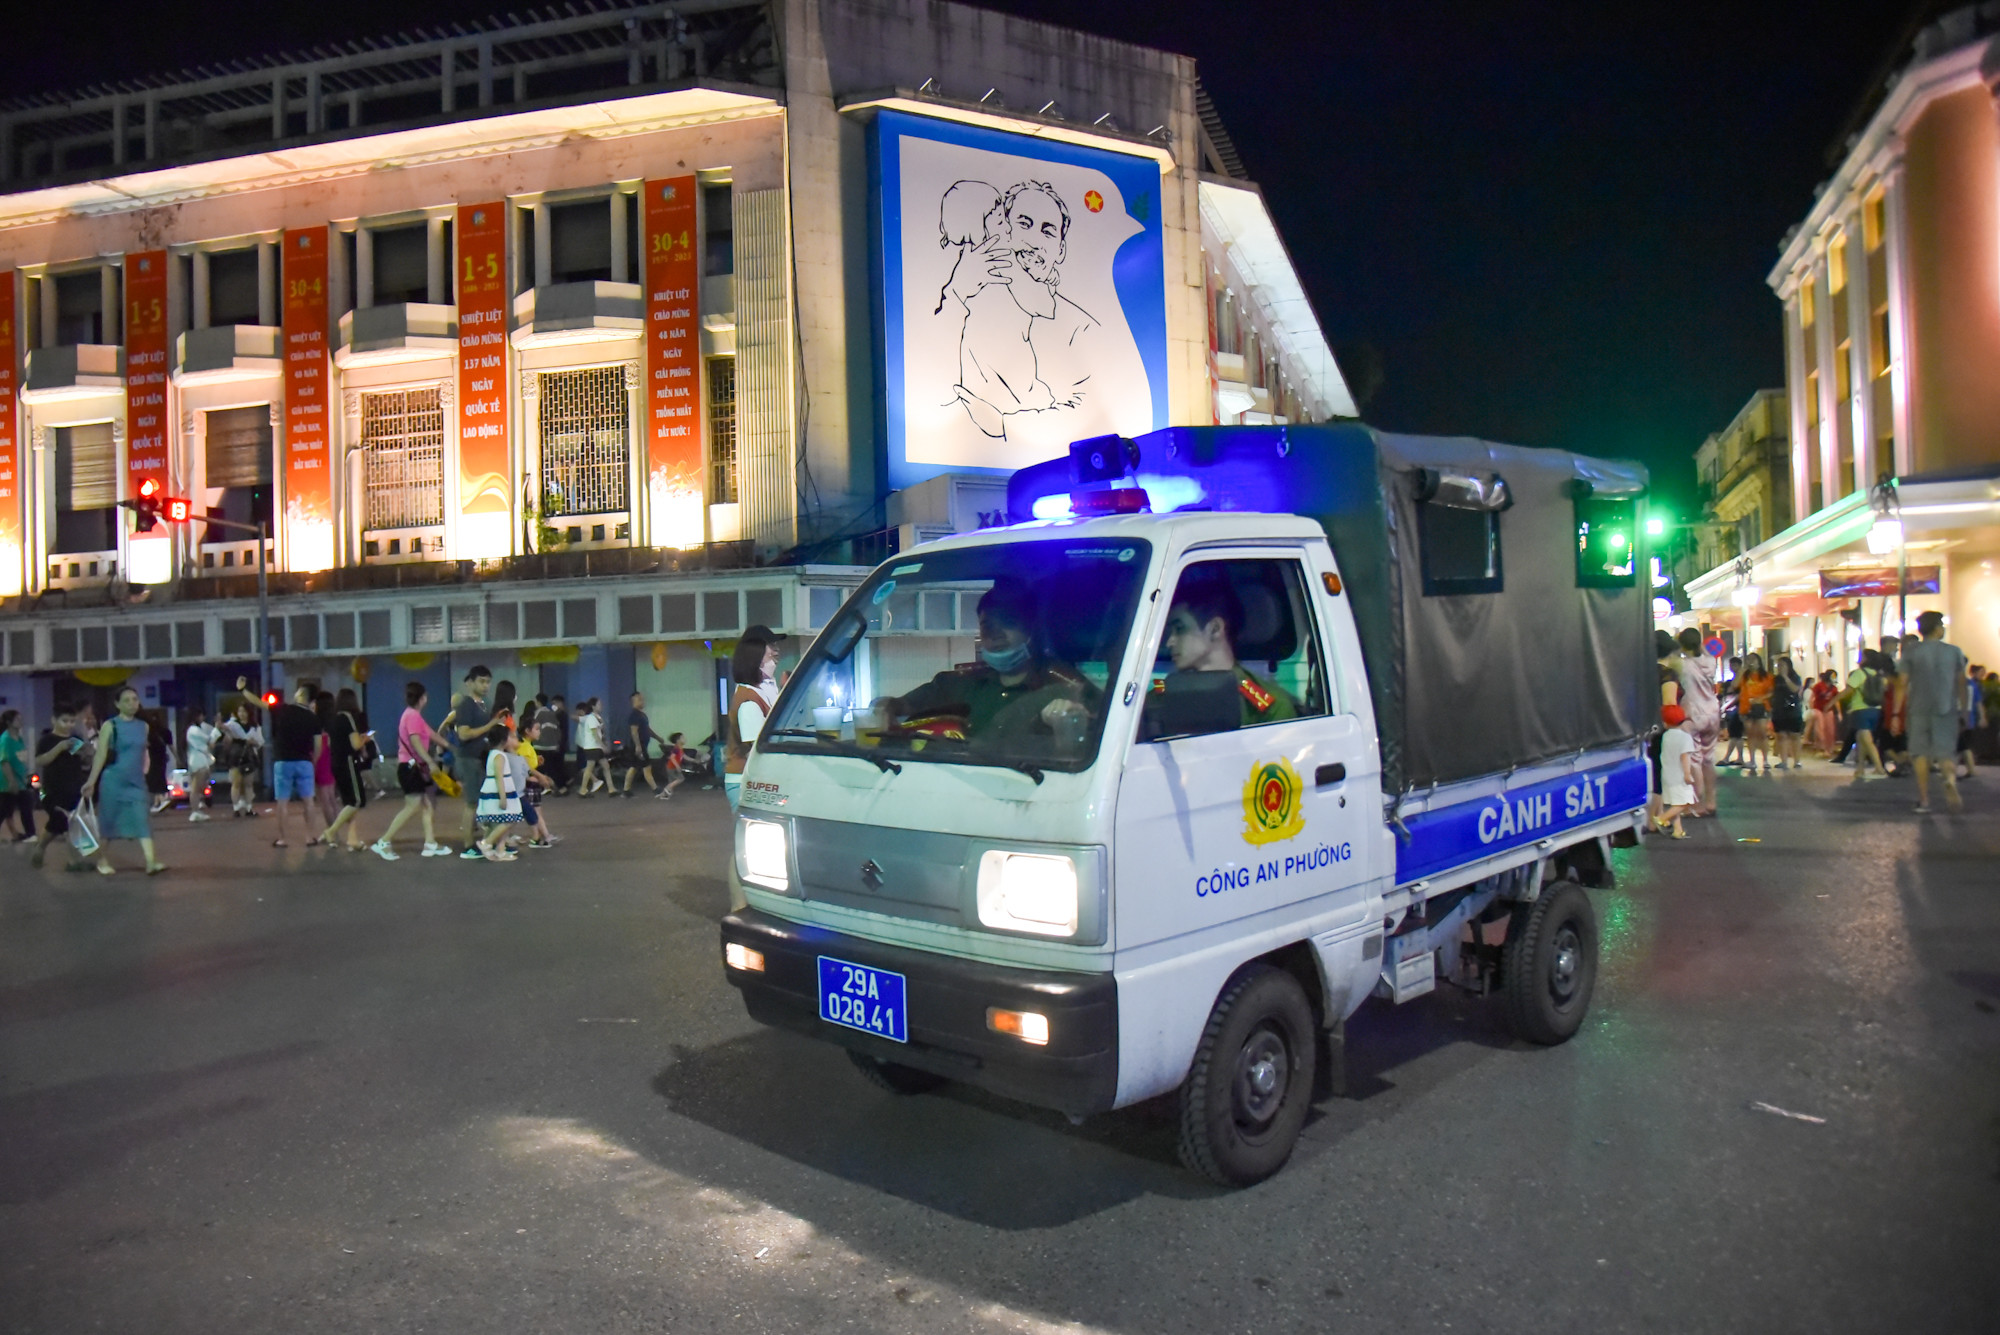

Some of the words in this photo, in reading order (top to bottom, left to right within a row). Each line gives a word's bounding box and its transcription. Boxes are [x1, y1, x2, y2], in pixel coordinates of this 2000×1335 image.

[652, 230, 689, 253] 30-4
[464, 253, 498, 281] 1-5
[461, 310, 484, 325] NHIỆT
[485, 308, 502, 323] LIỆT
[461, 334, 480, 347] CHÀO
[464, 358, 479, 370] 137
[481, 354, 501, 368] NĂM
[663, 348, 682, 359] NGÀY
[472, 377, 494, 392] NGÀY
[465, 398, 488, 417] QUỐC
[490, 397, 500, 412] TẾ
[463, 427, 477, 438] LAO
[478, 423, 498, 439] ĐỘNG
[746, 781, 779, 792] SUPER
[1196, 868, 1249, 897] CÔNG
[1256, 860, 1278, 883] AN
[1285, 842, 1351, 876] PHƯỜNG
[842, 966, 879, 1000] 29A
[828, 992, 894, 1035] 028.41
